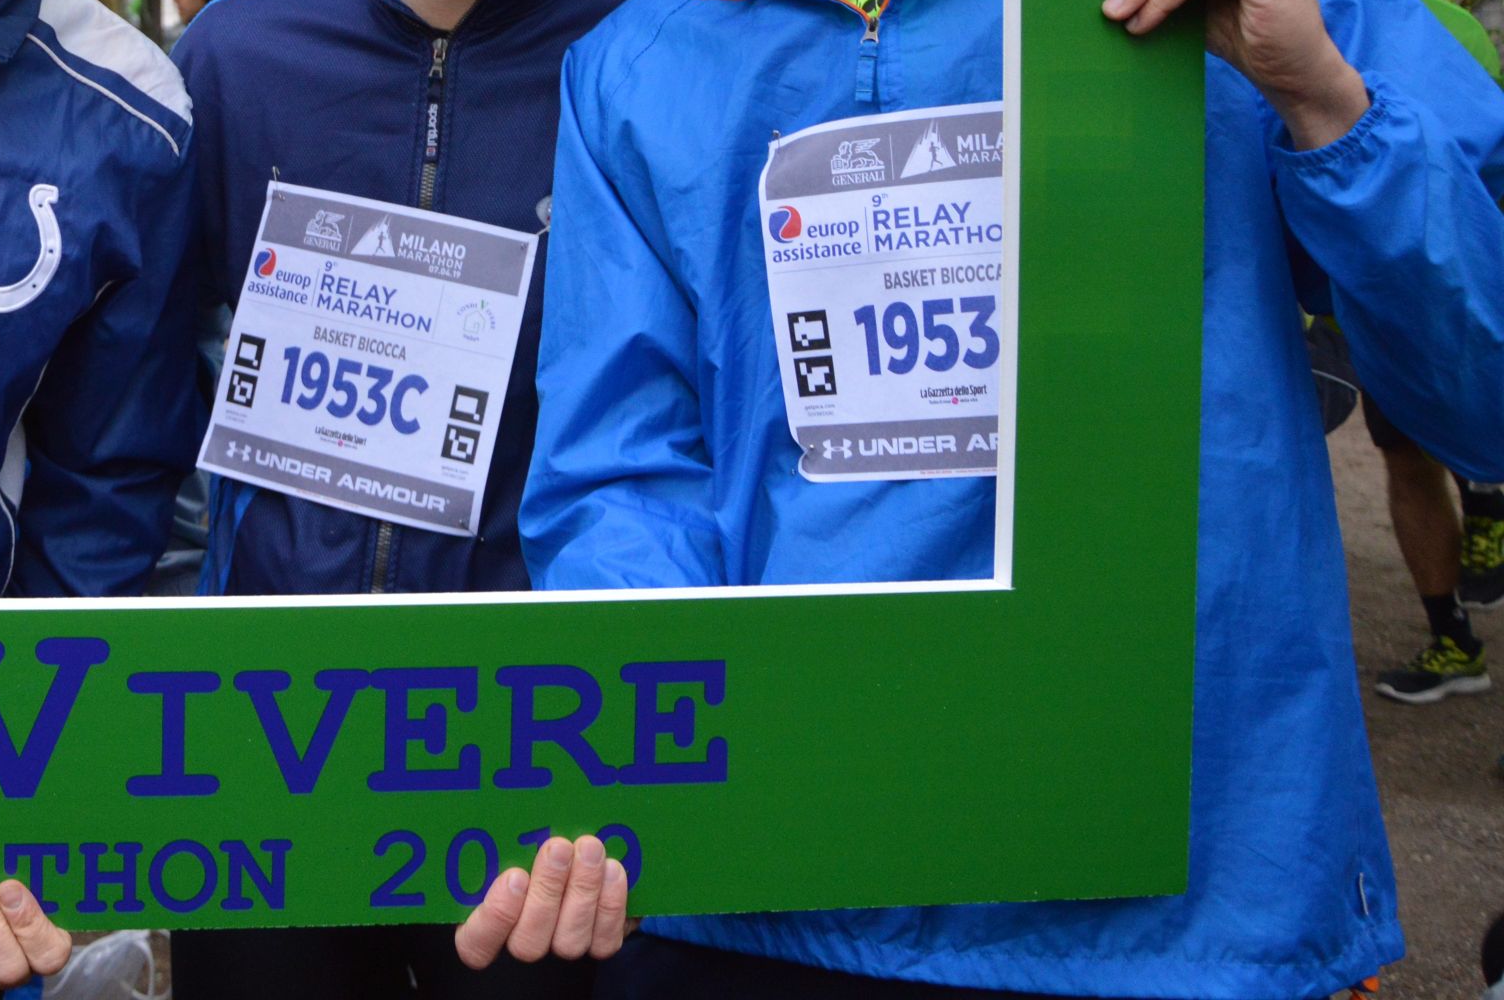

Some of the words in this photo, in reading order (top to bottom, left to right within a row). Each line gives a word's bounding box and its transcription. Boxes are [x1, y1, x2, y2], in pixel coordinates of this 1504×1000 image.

[832, 172, 886, 186] GENERALI
[873, 201, 972, 231] RELAY
[807, 219, 860, 241] europ
[303, 236, 342, 252] GENERALI
[399, 232, 467, 260] MILANO
[772, 240, 862, 264] assistance
[397, 248, 463, 271] MARATHON
[275, 269, 312, 291] europ
[320, 274, 398, 306] RELAY
[883, 268, 937, 290] BASKET
[247, 280, 308, 306] assistance
[316, 293, 433, 333] MARATHON
[313, 326, 357, 351] BASKET
[357, 337, 407, 362] BICOCCA
[853, 295, 1001, 376] 1953
[280, 346, 429, 435] 1953C
[928, 387, 954, 398] Gazzetta
[970, 383, 988, 397] Sport
[859, 433, 957, 457] UNDER
[254, 450, 332, 484] UNDER
[337, 473, 446, 512] ARMOUR
